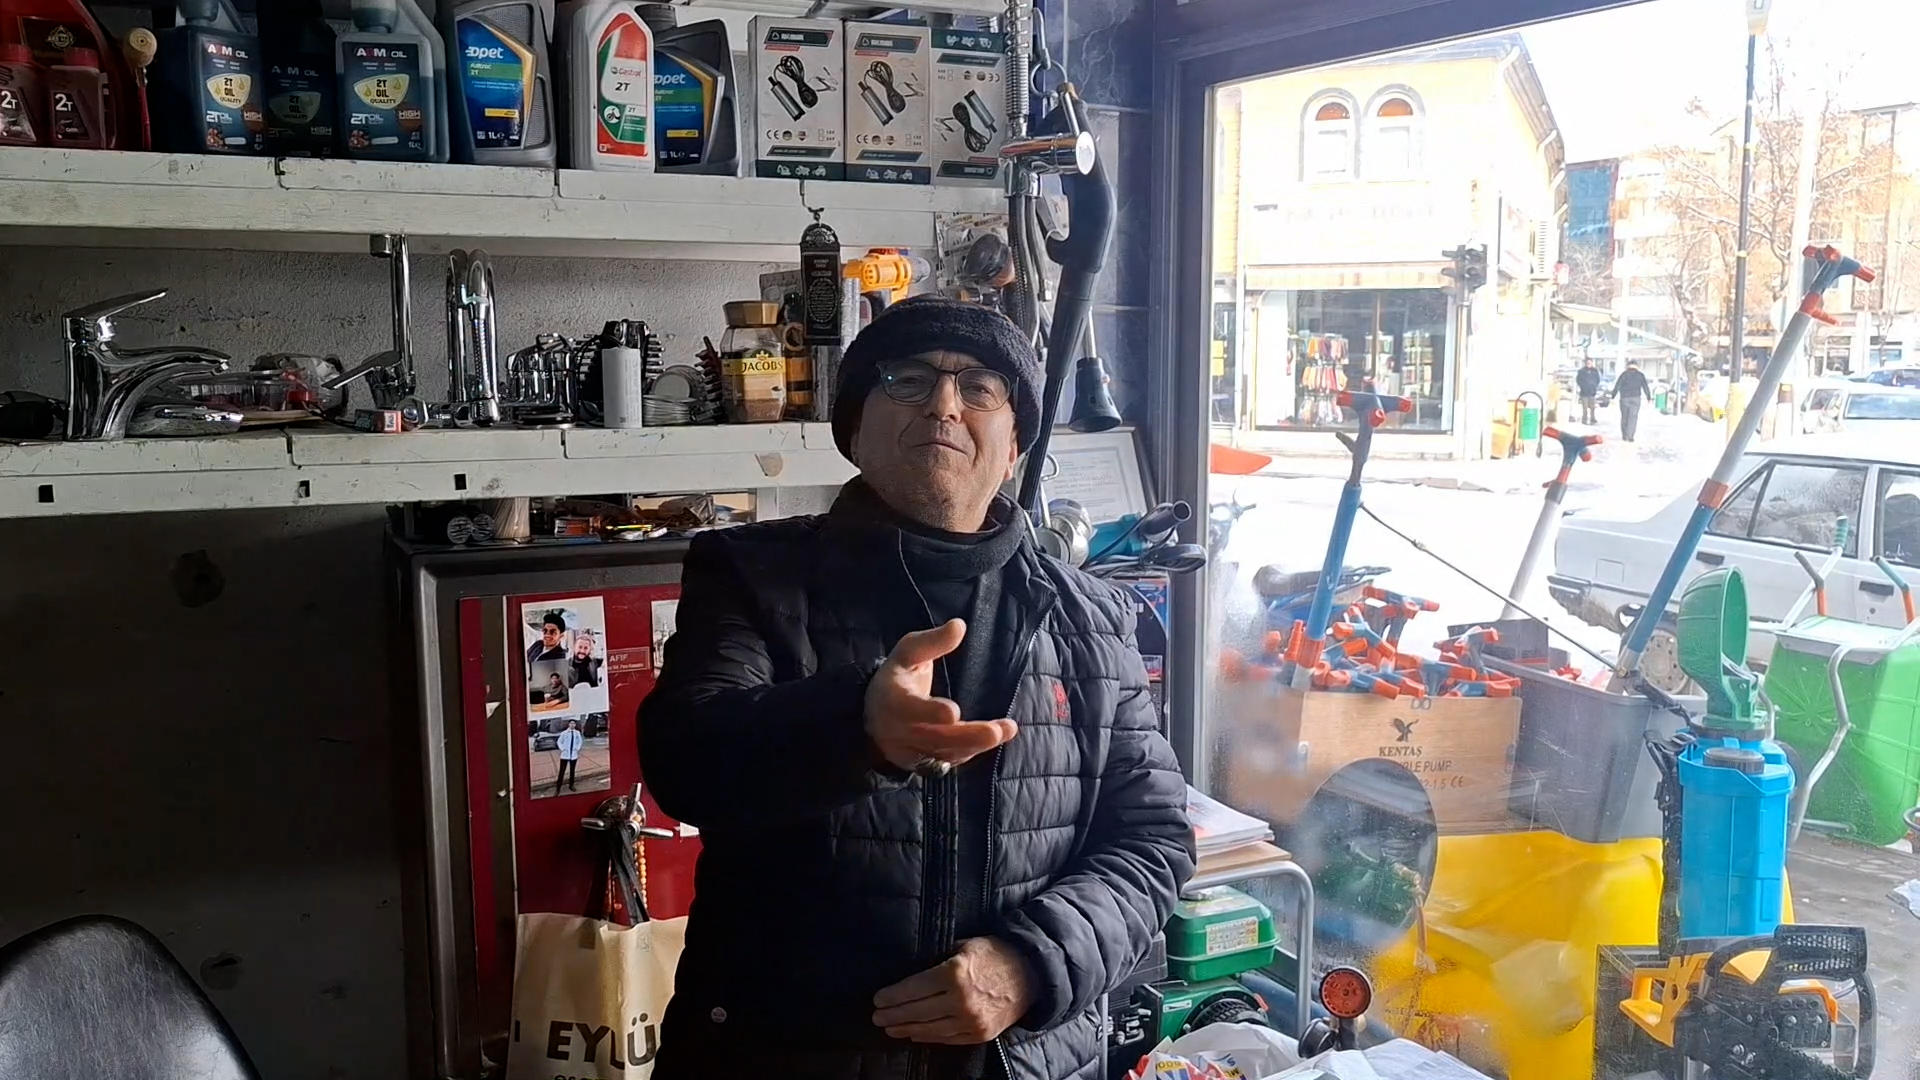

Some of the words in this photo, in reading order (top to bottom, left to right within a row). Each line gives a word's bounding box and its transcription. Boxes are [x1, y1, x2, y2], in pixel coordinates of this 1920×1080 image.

[391, 50, 408, 58] OIL
[618, 66, 642, 77] Castrol
[223, 77, 234, 87] 2T
[376, 79, 388, 88] 2T
[614, 82, 631, 92] 2T
[224, 88, 236, 97] OIL
[375, 88, 389, 98] OIL
[0, 90, 18, 109] 2T
[54, 93, 74, 112] 2T
[350, 113, 369, 124] 2T
[398, 109, 420, 120] HIGH
[741, 361, 783, 374] JACOBS
[1378, 746, 1423, 758] KENTAŞ
[1422, 760, 1452, 772] PUMP
